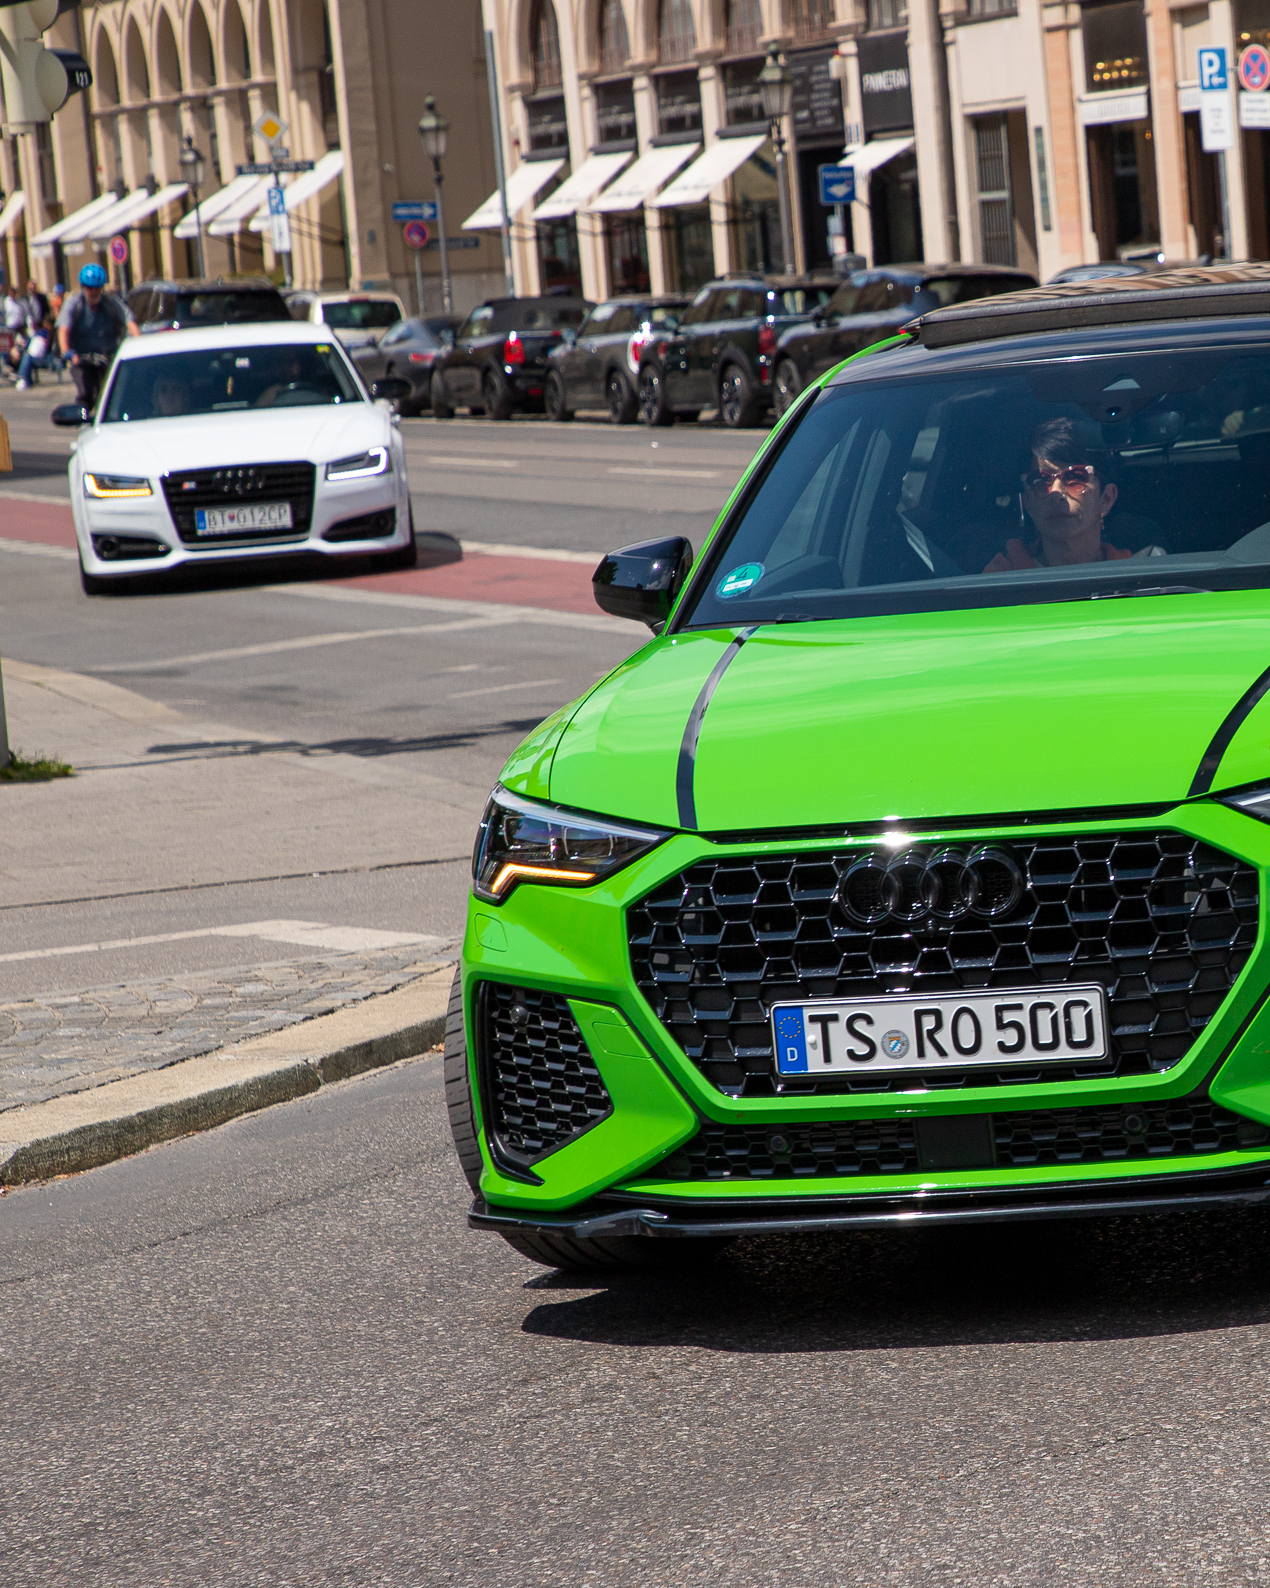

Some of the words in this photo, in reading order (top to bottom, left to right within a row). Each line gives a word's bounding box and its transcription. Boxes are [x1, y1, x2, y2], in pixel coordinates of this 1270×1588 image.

[1200, 51, 1221, 88] P
[808, 1012, 877, 1063] TS
[914, 1004, 982, 1058] RO
[995, 999, 1094, 1054] 500
[787, 1047, 798, 1062] D
